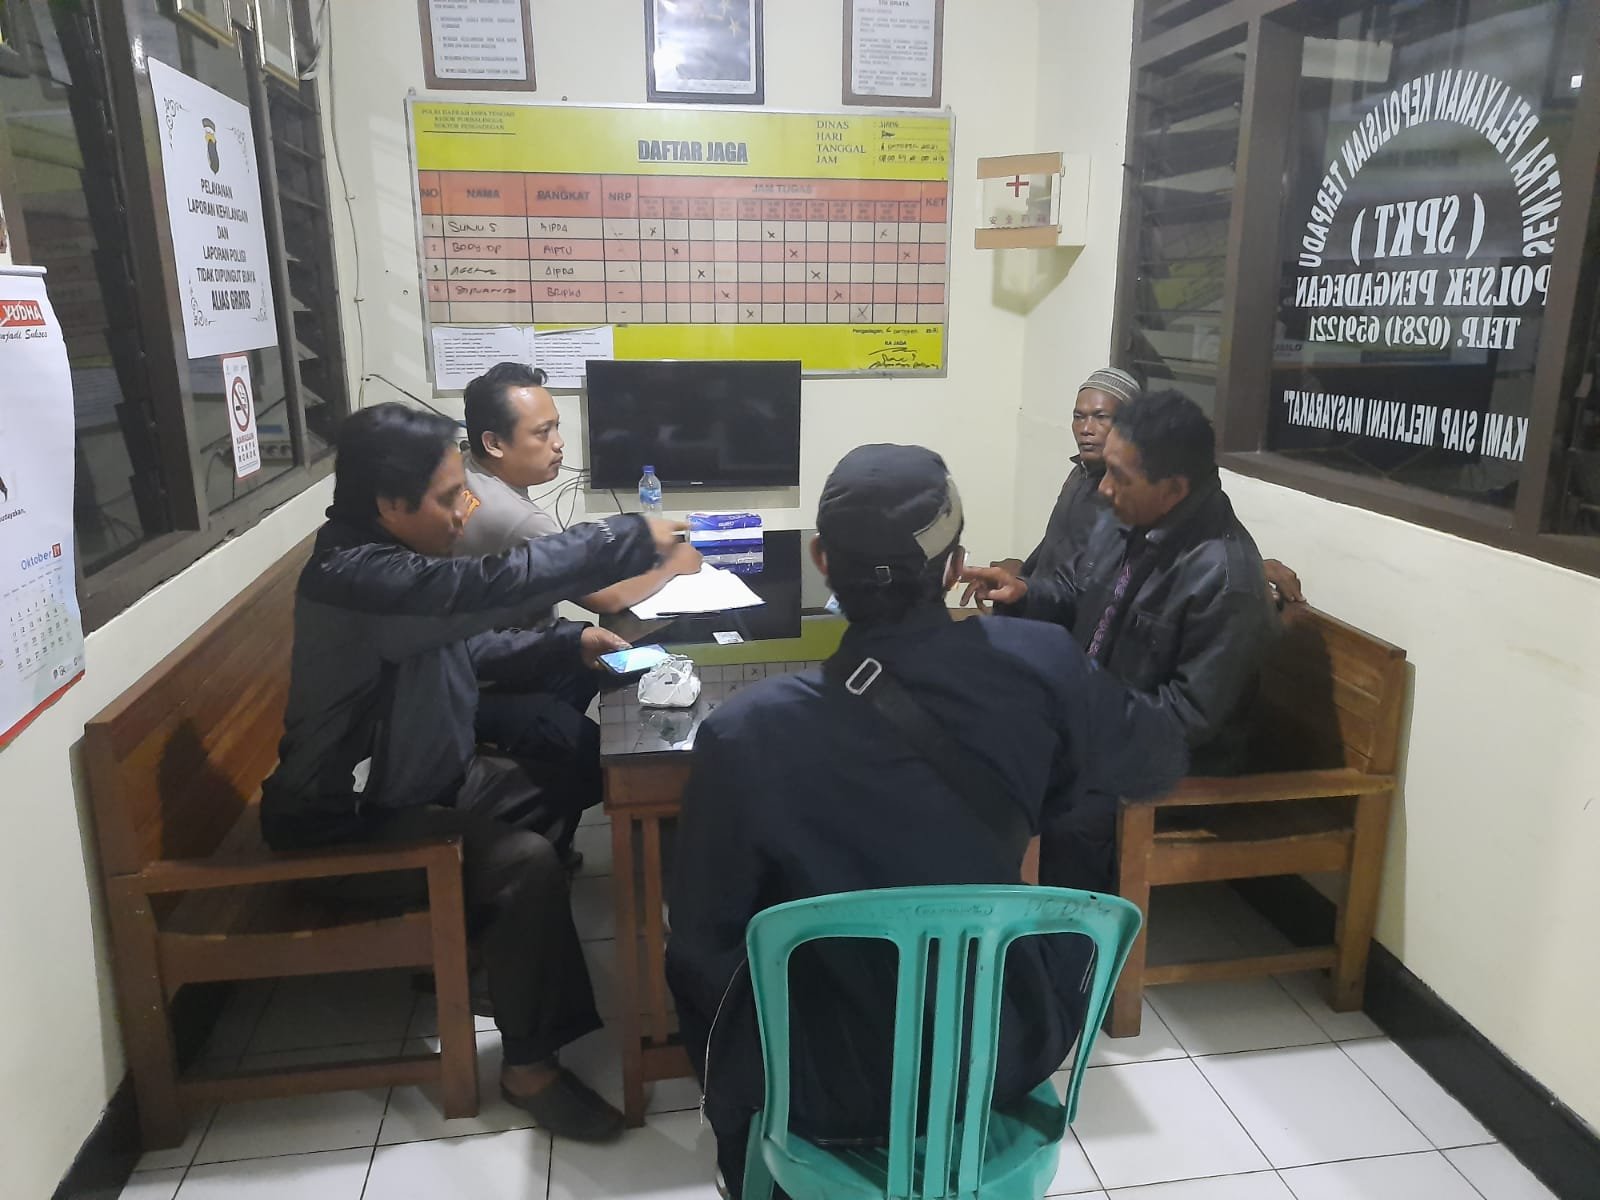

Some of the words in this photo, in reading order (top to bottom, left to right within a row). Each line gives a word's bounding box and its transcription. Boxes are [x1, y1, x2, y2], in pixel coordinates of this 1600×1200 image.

[817, 120, 849, 129] DINAS
[817, 131, 842, 141] HARI
[638, 140, 702, 161] DAFTAR
[706, 141, 748, 162] JAGA
[816, 143, 866, 154] TANGGAL
[817, 155, 837, 164] JAM
[201, 179, 233, 199] PELAYANAN
[421, 187, 439, 198] NO
[467, 188, 500, 198] NAMA
[752, 184, 775, 194] JAM
[537, 190, 591, 200] PANGKAT
[608, 192, 632, 201] NRP
[926, 197, 945, 206] KET
[187, 198, 216, 218] LAPORAN
[216, 204, 249, 223] KEHILANGAN
[216, 226, 229, 240] DAN
[203, 246, 229, 262] LAPORAN
[196, 268, 215, 282] TIDAK
[215, 269, 242, 283] DIPUNGUT
[211, 290, 230, 310] ALIAS
[230, 290, 251, 310] GRATIS
[3, 303, 42, 321] YUDHA
[20, 550, 52, 570] Oktober
